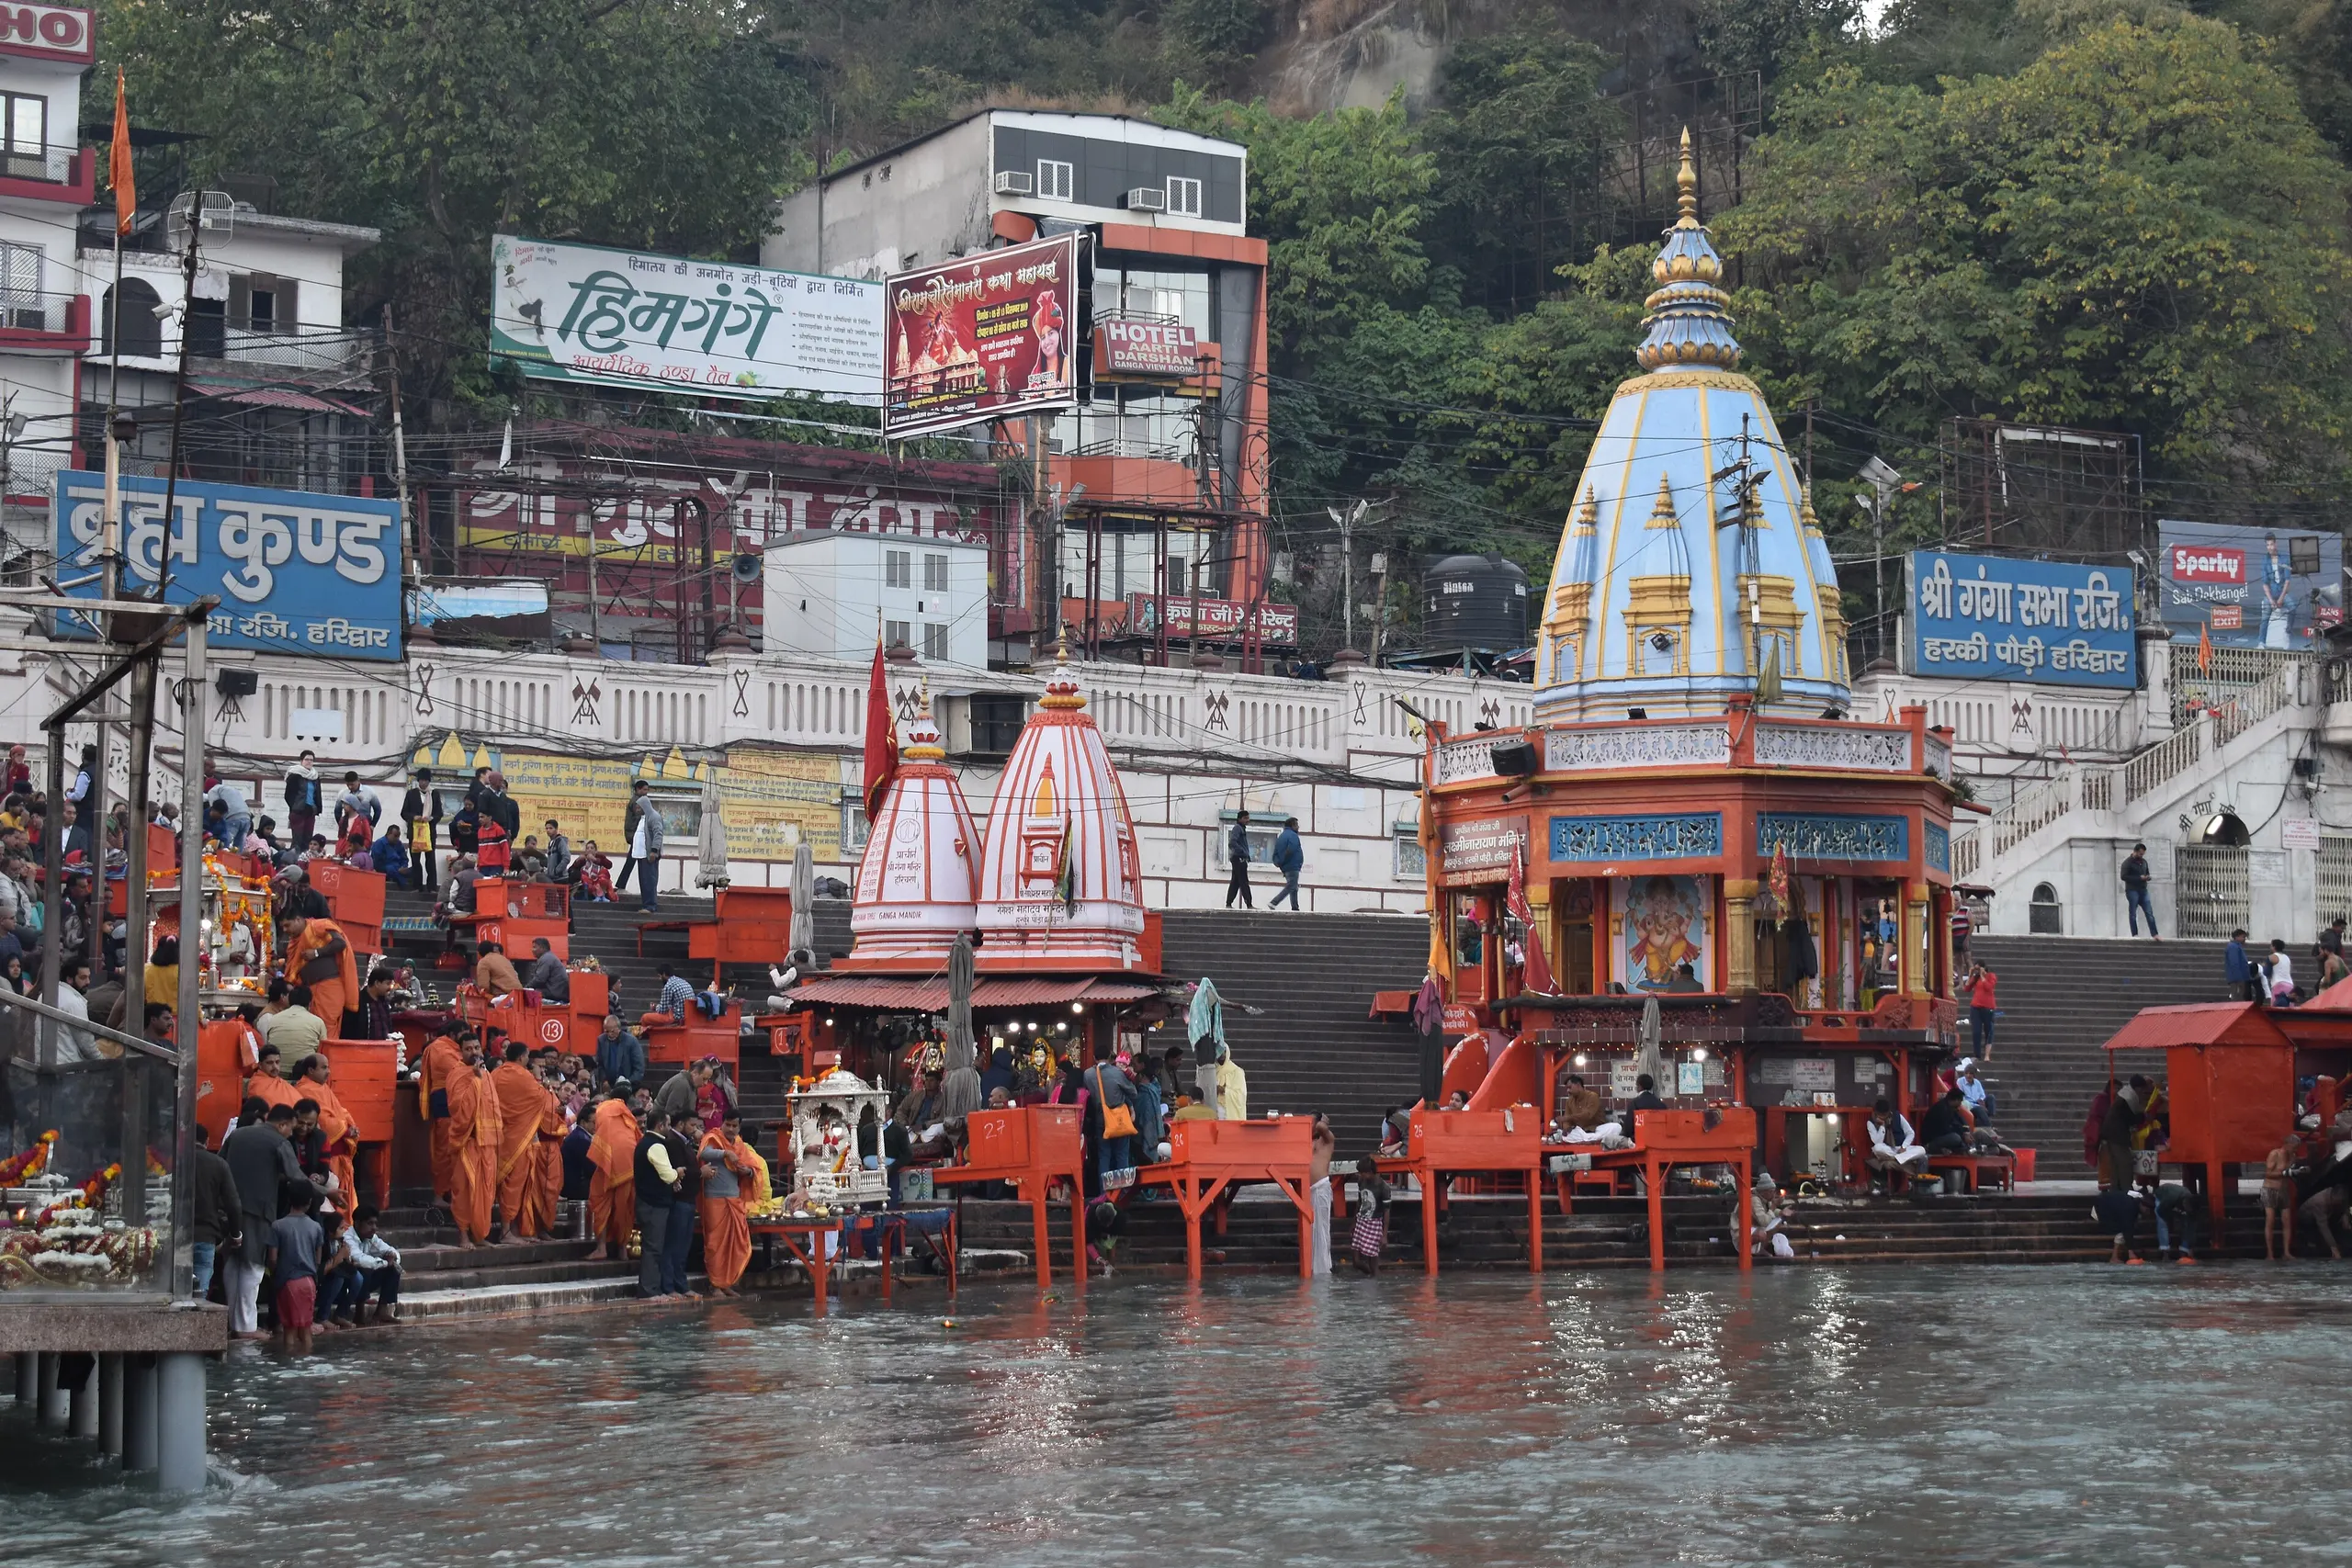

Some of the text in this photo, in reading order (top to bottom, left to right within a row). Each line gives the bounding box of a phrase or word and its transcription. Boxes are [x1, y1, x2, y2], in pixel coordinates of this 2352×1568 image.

[628, 256, 865, 299] हिमालय की अनमोल जड़ी-बूटियों द्वारा निर्मित
[987, 272, 1012, 291] कथा
[1016, 261, 1059, 285] महायज्ञ
[557, 270, 784, 360] हिमगंगे
[1109, 322, 1194, 346] HOTEL
[1129, 343, 1179, 355] AARTI
[1114, 351, 1194, 366] DARSHAN
[1115, 360, 1143, 369] GANGA
[1169, 366, 1197, 374] ROOMS
[573, 354, 732, 386] आयुर्वेदिक ठण्डा तैल
[68, 486, 391, 603] ब्रह्म कुण्ड
[2176, 550, 2239, 579] Sparky
[1443, 581, 1474, 593] Sintex
[1920, 558, 2129, 631] श्री गंगा सभा रजि.
[1210, 604, 1233, 623] जी
[2214, 617, 2238, 626] EXIT
[239, 612, 298, 640] रजि.
[306, 617, 390, 649] हरिद्वार
[1923, 632, 2128, 676] हरकी पौड़ी हरिद्वार
[2179, 801, 2211, 832] श्री गंगा
[1479, 822, 1491, 831] गंगा
[1492, 820, 1500, 830] जी
[1443, 835, 1497, 854] लक्ष्मीनारायण
[1034, 852, 1049, 863] प्राचीन
[1464, 870, 1473, 885] श्री
[878, 910, 922, 919] GANGA MANDIR
[547, 1023, 560, 1038] 13
[1621, 1064, 1637, 1073] प्राची
[1635, 1113, 1645, 1126] 24
[984, 1120, 1005, 1139] 27
[1414, 1124, 1423, 1138] 25
[1174, 1133, 1184, 1147] 26
